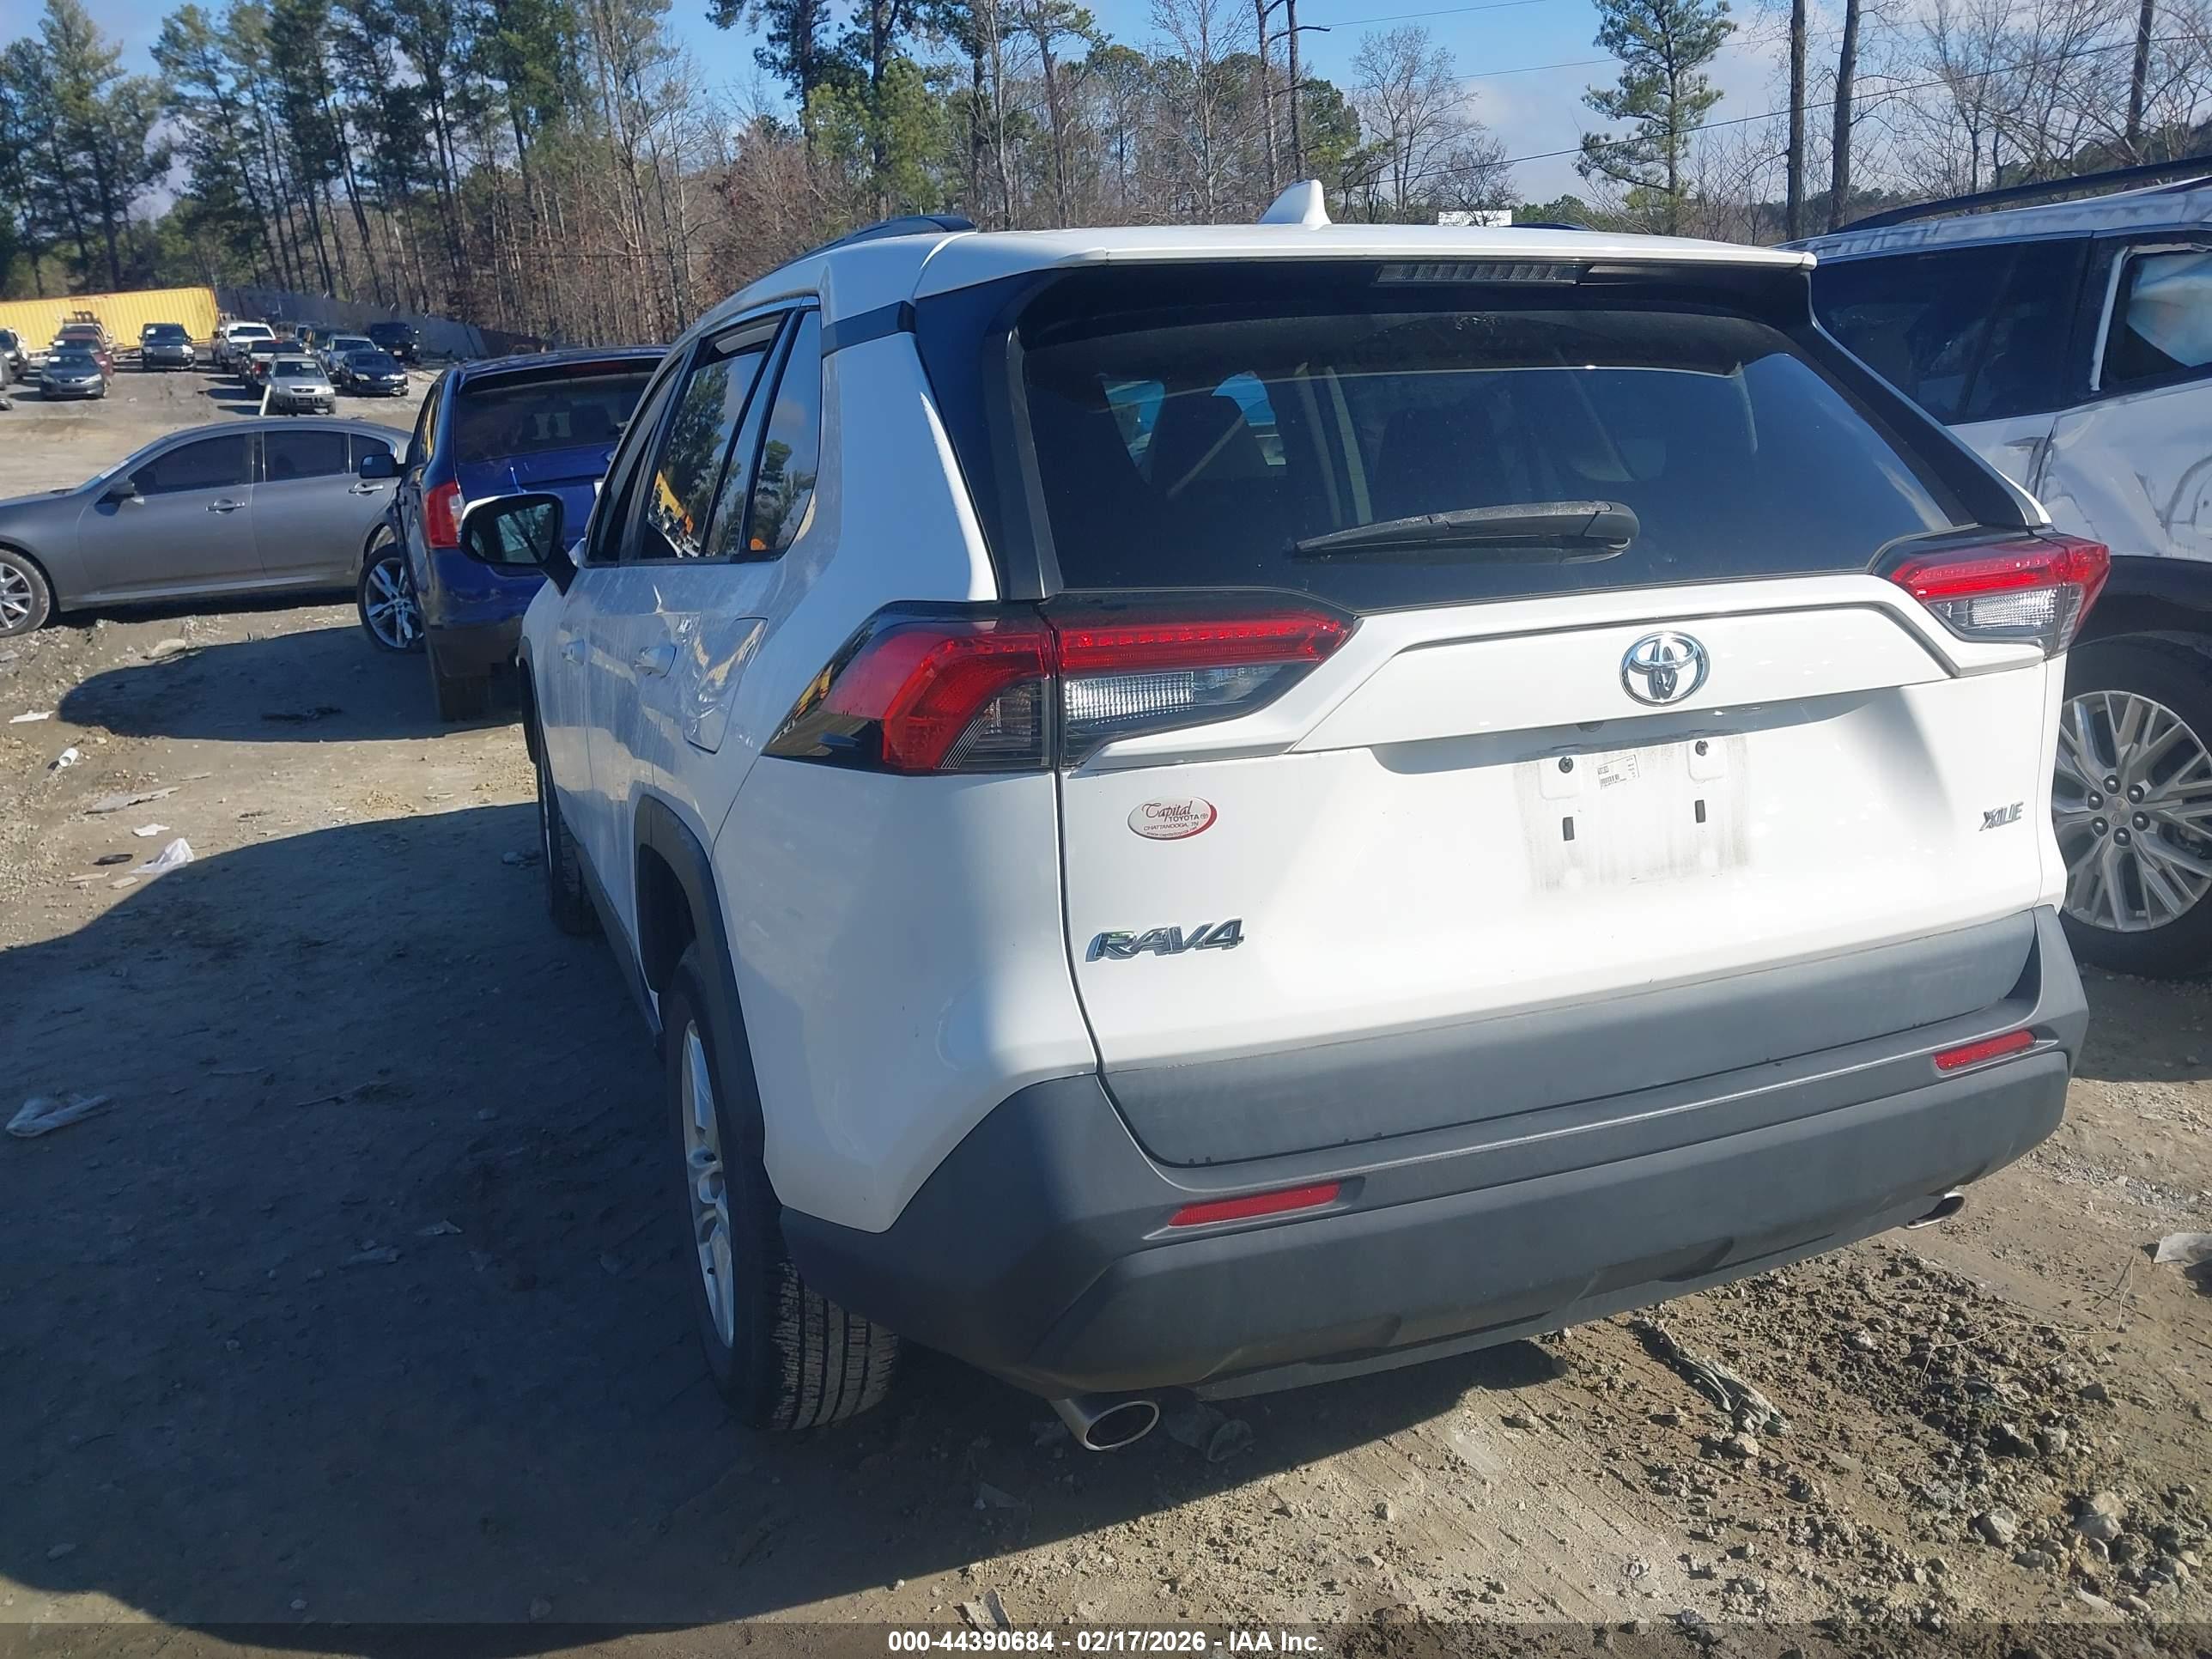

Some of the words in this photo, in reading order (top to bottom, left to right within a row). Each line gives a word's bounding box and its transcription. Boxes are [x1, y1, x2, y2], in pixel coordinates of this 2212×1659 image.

[1142, 800, 1193, 822] Capital
[1978, 801, 2024, 831] XLE
[1085, 918, 1244, 962] RAV4
